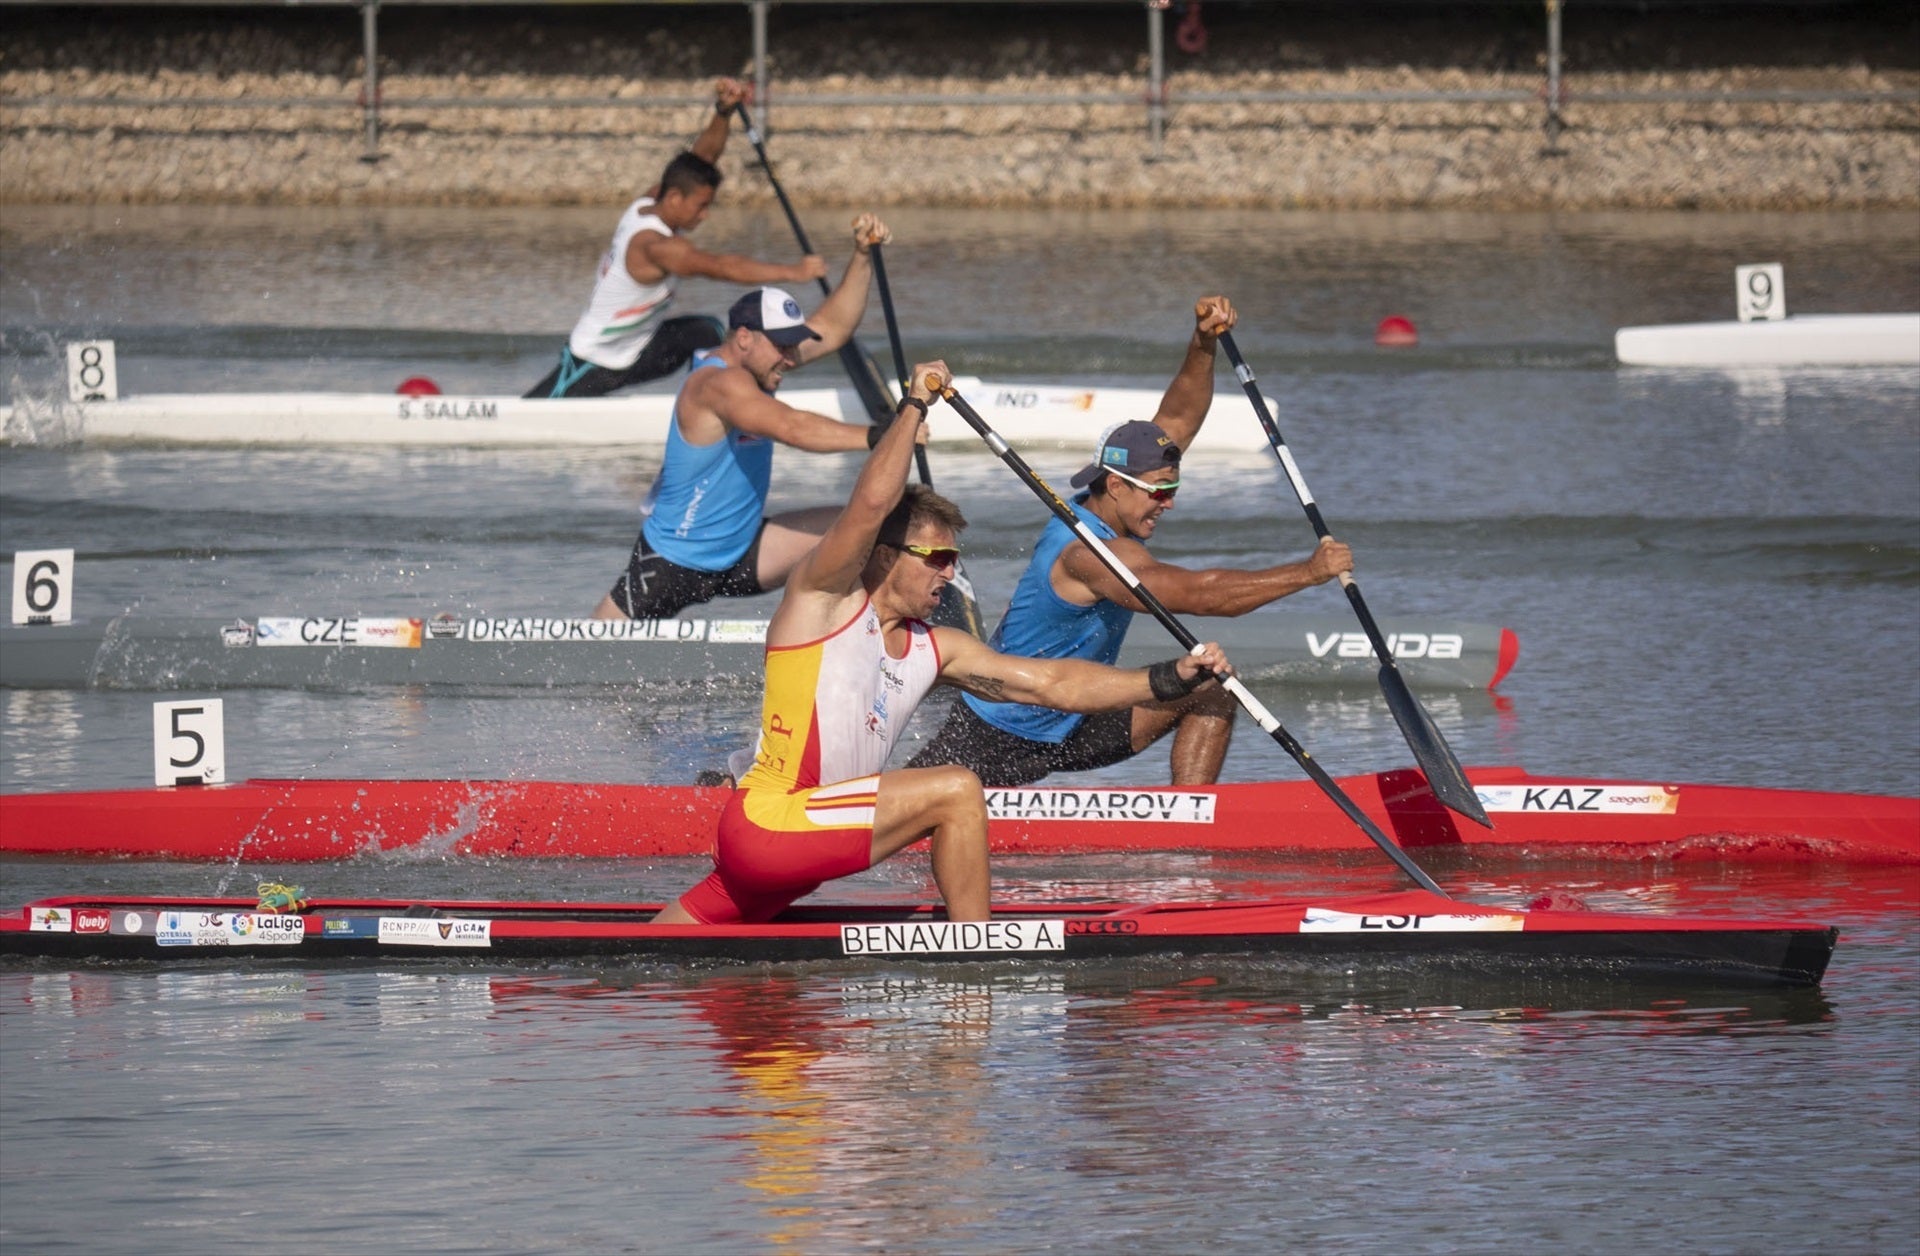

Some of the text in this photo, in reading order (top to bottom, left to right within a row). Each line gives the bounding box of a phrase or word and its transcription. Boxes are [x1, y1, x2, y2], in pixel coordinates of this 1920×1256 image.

[1749, 271, 1773, 311] 9
[80, 346, 104, 389] 8
[423, 400, 498, 420] SALAM
[995, 390, 1038, 409] IND
[25, 560, 60, 613] 6
[301, 618, 359, 643] CZE
[472, 618, 668, 640] DRAHOKOUPIL
[677, 619, 702, 640] D.
[169, 707, 205, 768] 5
[985, 791, 1211, 821] KHAIDAROV T.
[1521, 788, 1604, 811] KAZ
[79, 914, 108, 930] Quely
[257, 915, 303, 931] LaLiga
[454, 923, 486, 934] UCAM
[258, 930, 304, 943] 4Sports
[844, 922, 1063, 953] BENAVIDES A.
